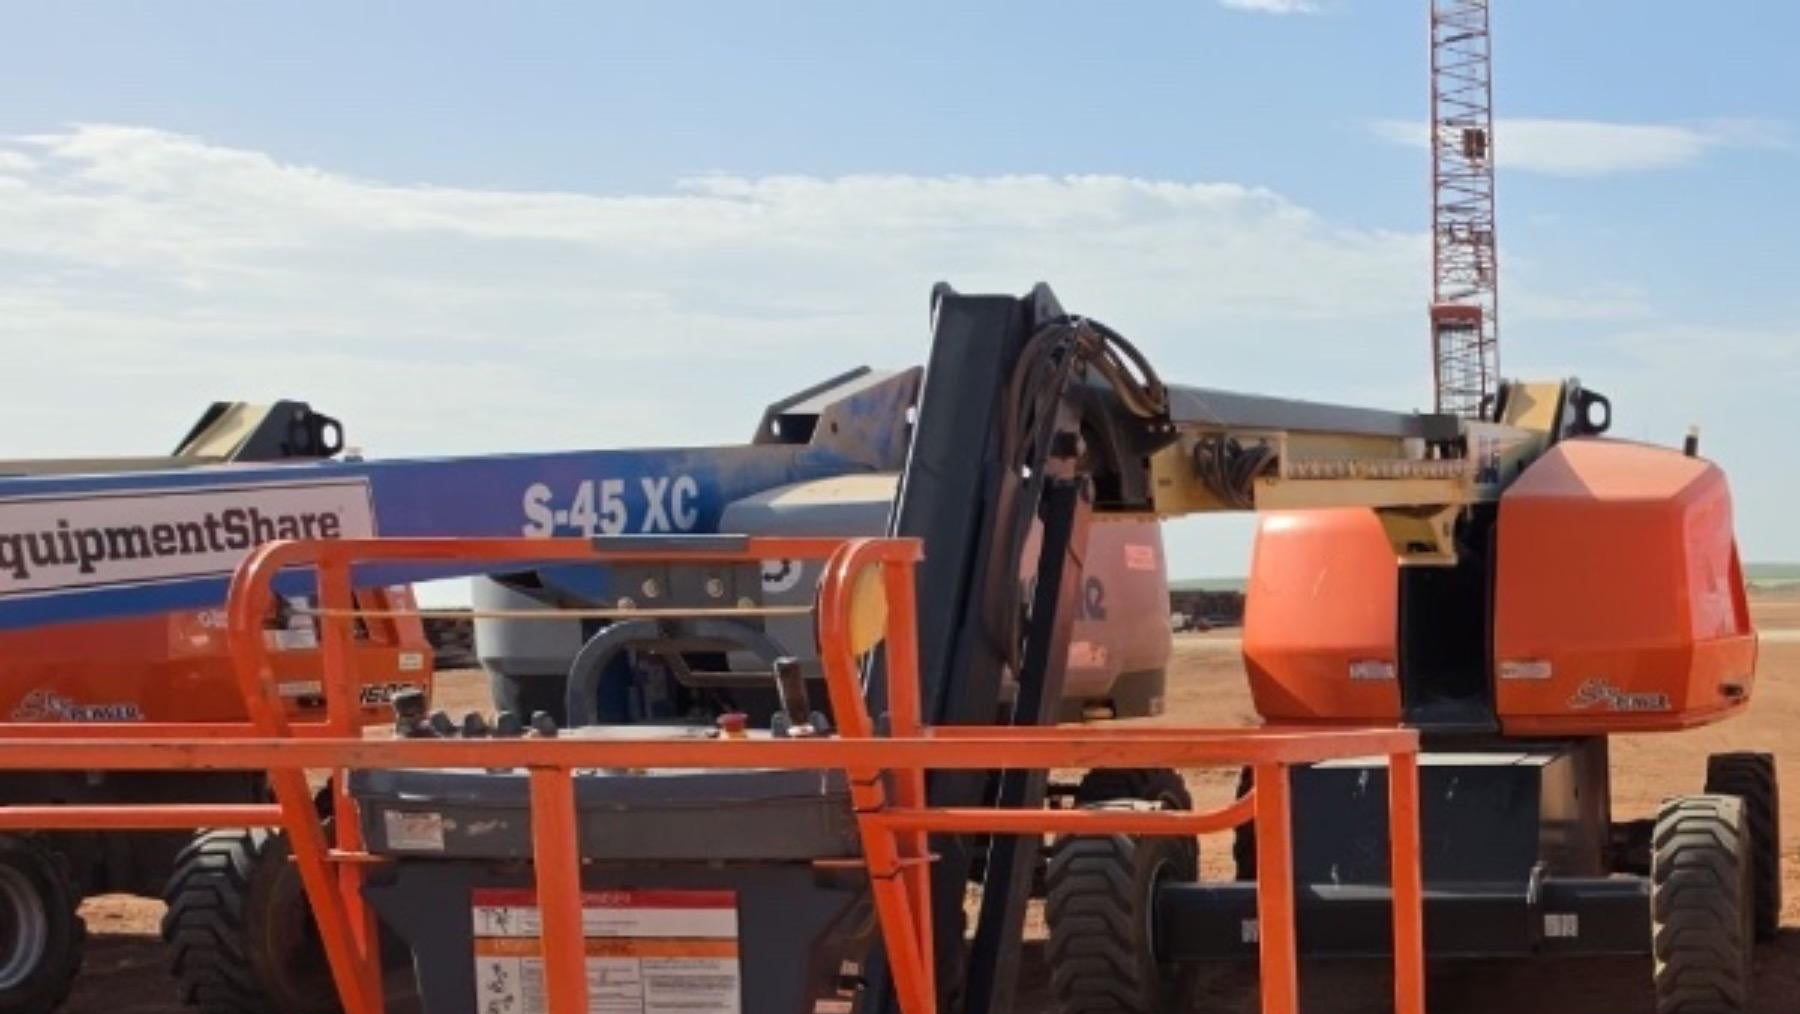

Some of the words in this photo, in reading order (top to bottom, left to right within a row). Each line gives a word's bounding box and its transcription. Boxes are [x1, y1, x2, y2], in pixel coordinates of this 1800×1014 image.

[522, 479, 628, 539] S-45
[641, 475, 698, 533] XC
[0, 507, 341, 580] quipmentShare
